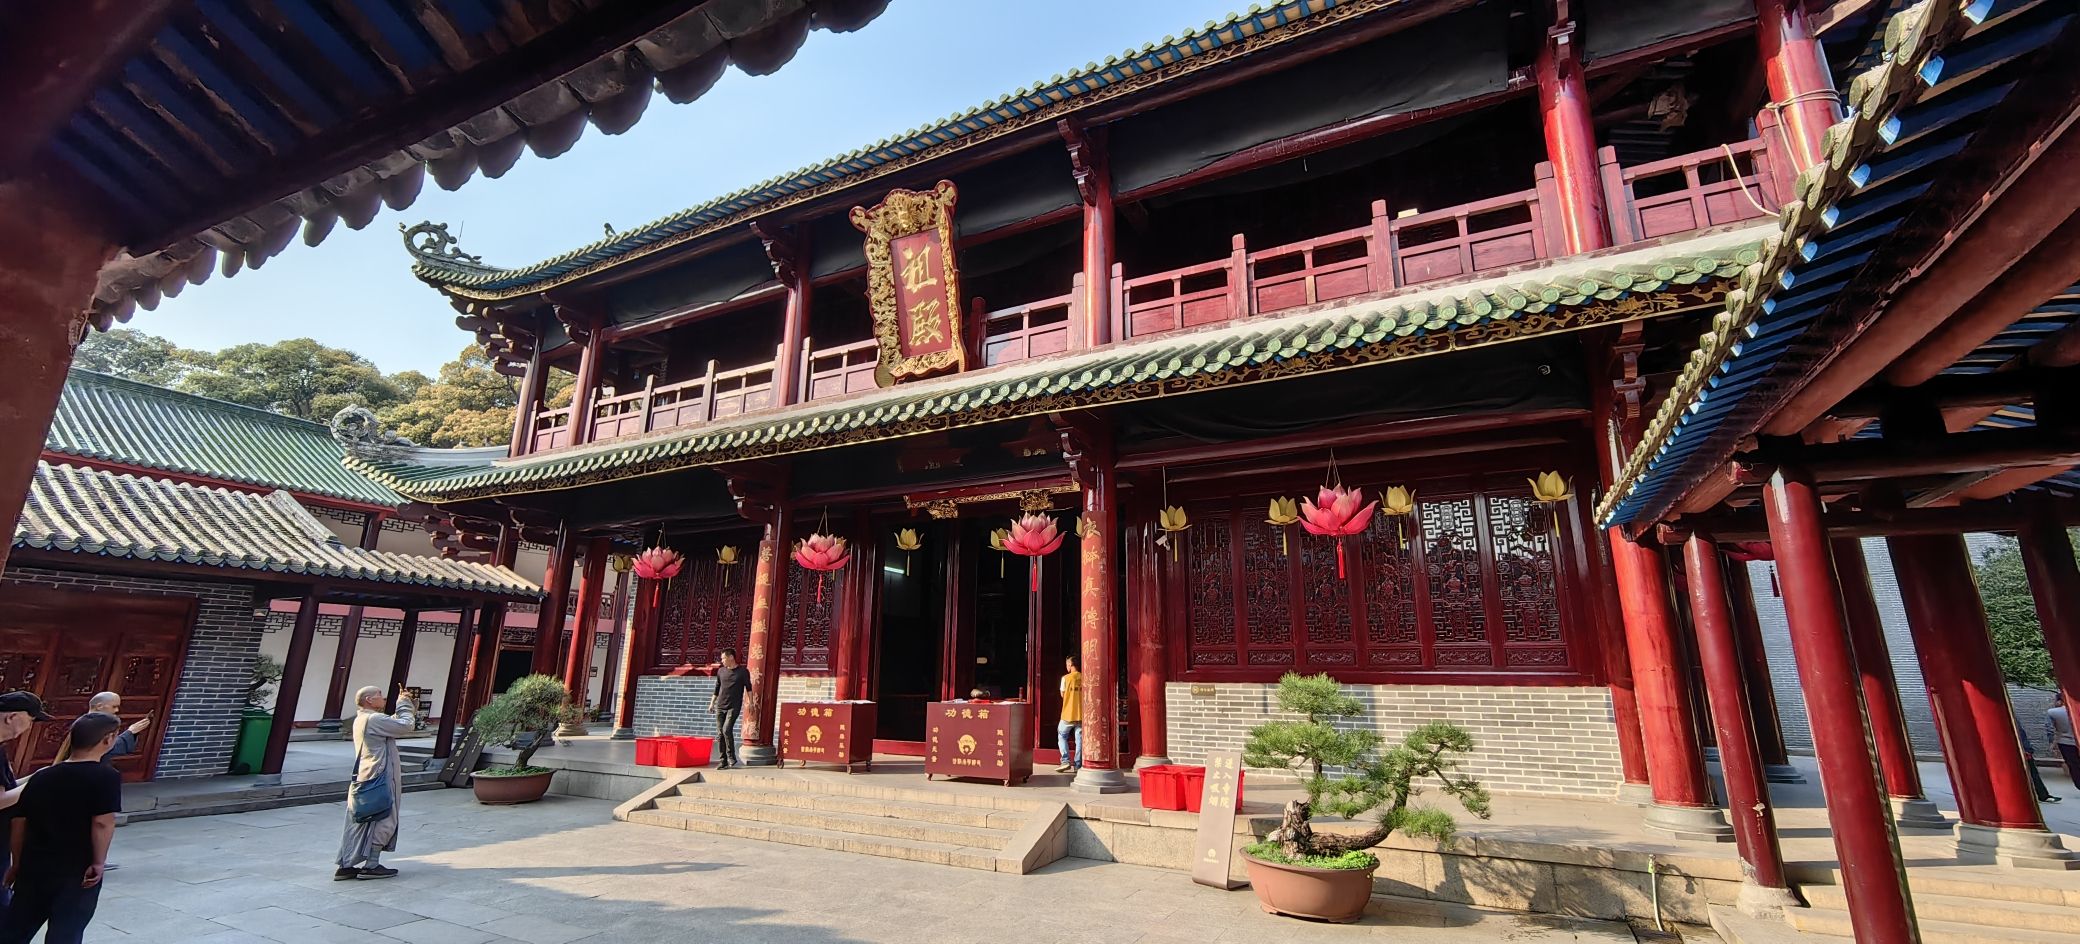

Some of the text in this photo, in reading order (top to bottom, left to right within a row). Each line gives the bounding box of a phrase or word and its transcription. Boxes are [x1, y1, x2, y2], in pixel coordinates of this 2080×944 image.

[901, 244, 943, 345] 祖殿
[797, 707, 833, 717] 功德箱
[945, 708, 990, 719] 功德箱
